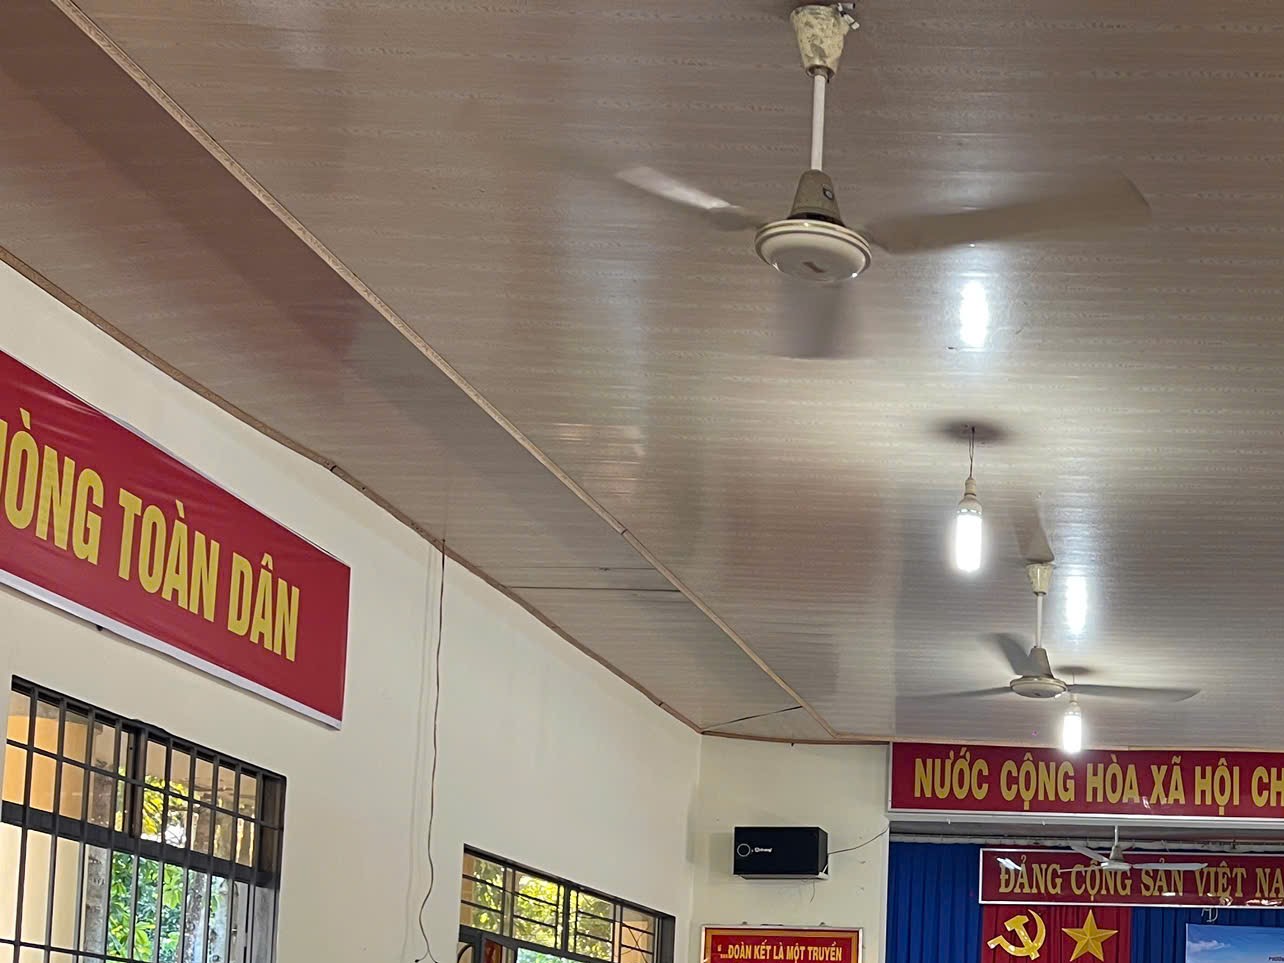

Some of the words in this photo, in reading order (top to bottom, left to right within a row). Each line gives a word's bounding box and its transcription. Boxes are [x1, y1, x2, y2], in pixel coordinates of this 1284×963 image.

[0, 407, 104, 566] ÒNG
[118, 487, 220, 623] TOÀN
[227, 552, 300, 662] DÂN
[914, 747, 989, 799] NƯỚC
[1000, 752, 1075, 811] CỘNG
[1086, 753, 1143, 804] HÒA
[1150, 756, 1186, 806] XÃ
[1195, 758, 1240, 815] HỘI
[998, 855, 1063, 895] ĐẢNG
[1070, 859, 1133, 902] CỘNG
[1141, 858, 1184, 897] SẢN
[1194, 861, 1247, 902] VIỆT
[754, 940, 771, 960] KẾT
[773, 942, 784, 960] LÀ
[786, 943, 805, 963] MỘT
